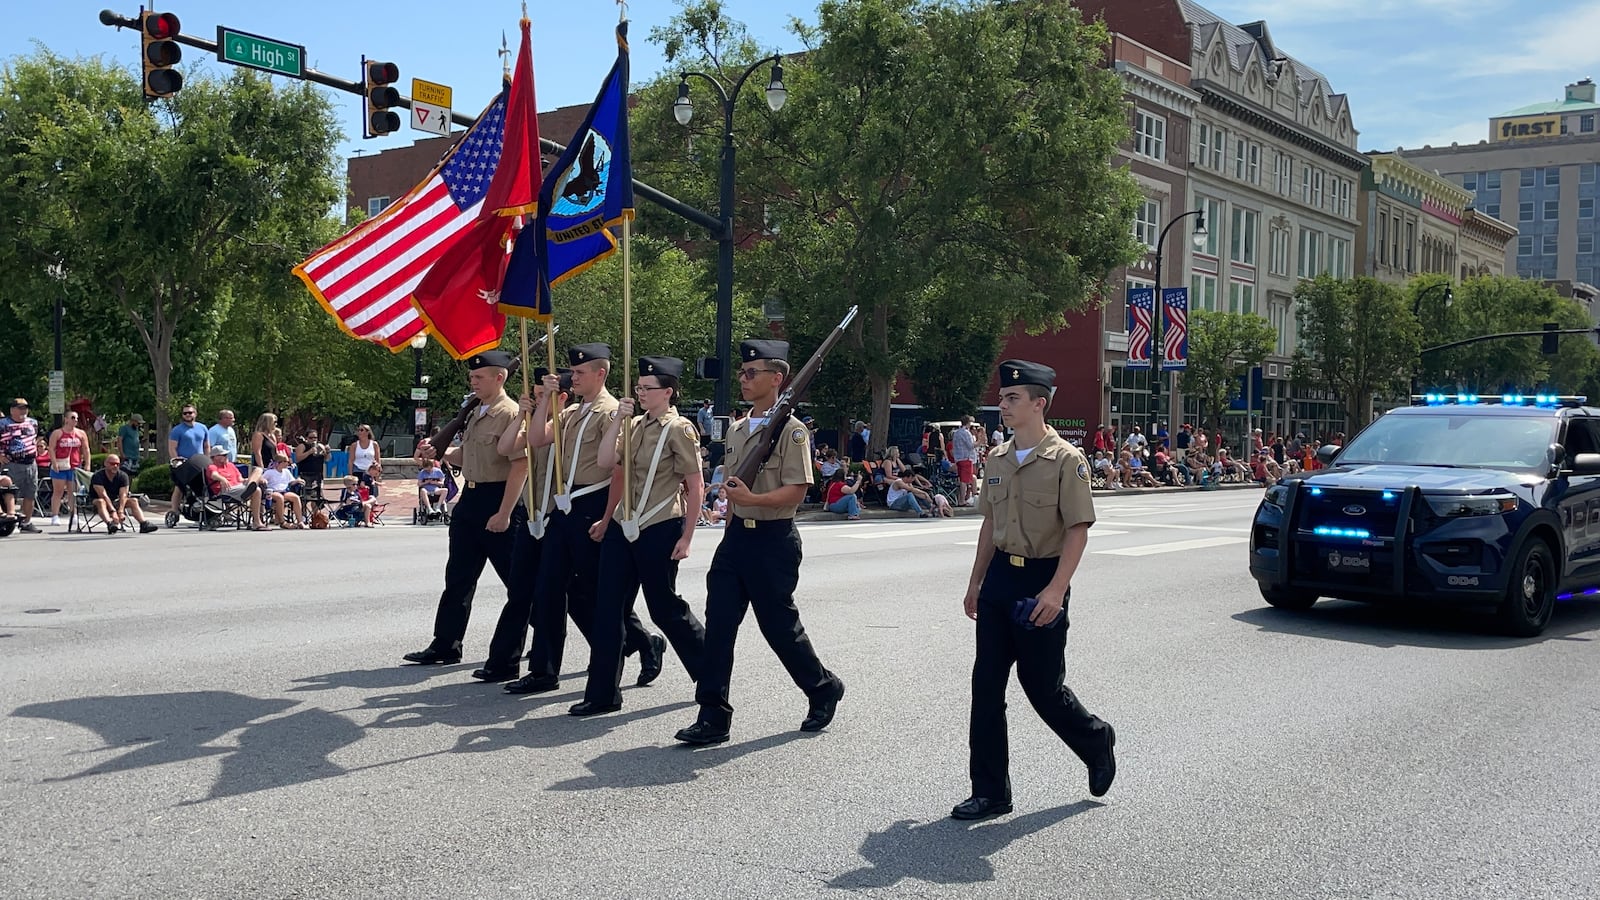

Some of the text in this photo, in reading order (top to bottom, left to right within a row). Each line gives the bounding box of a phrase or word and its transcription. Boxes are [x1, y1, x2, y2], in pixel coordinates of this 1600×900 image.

[251, 43, 296, 68] High St
[419, 83, 445, 97] TURNING
[419, 92, 444, 104] TRAFFIC
[556, 224, 590, 241] UNITED
[1047, 419, 1086, 427] STRONG
[1447, 575, 1480, 586] 004
